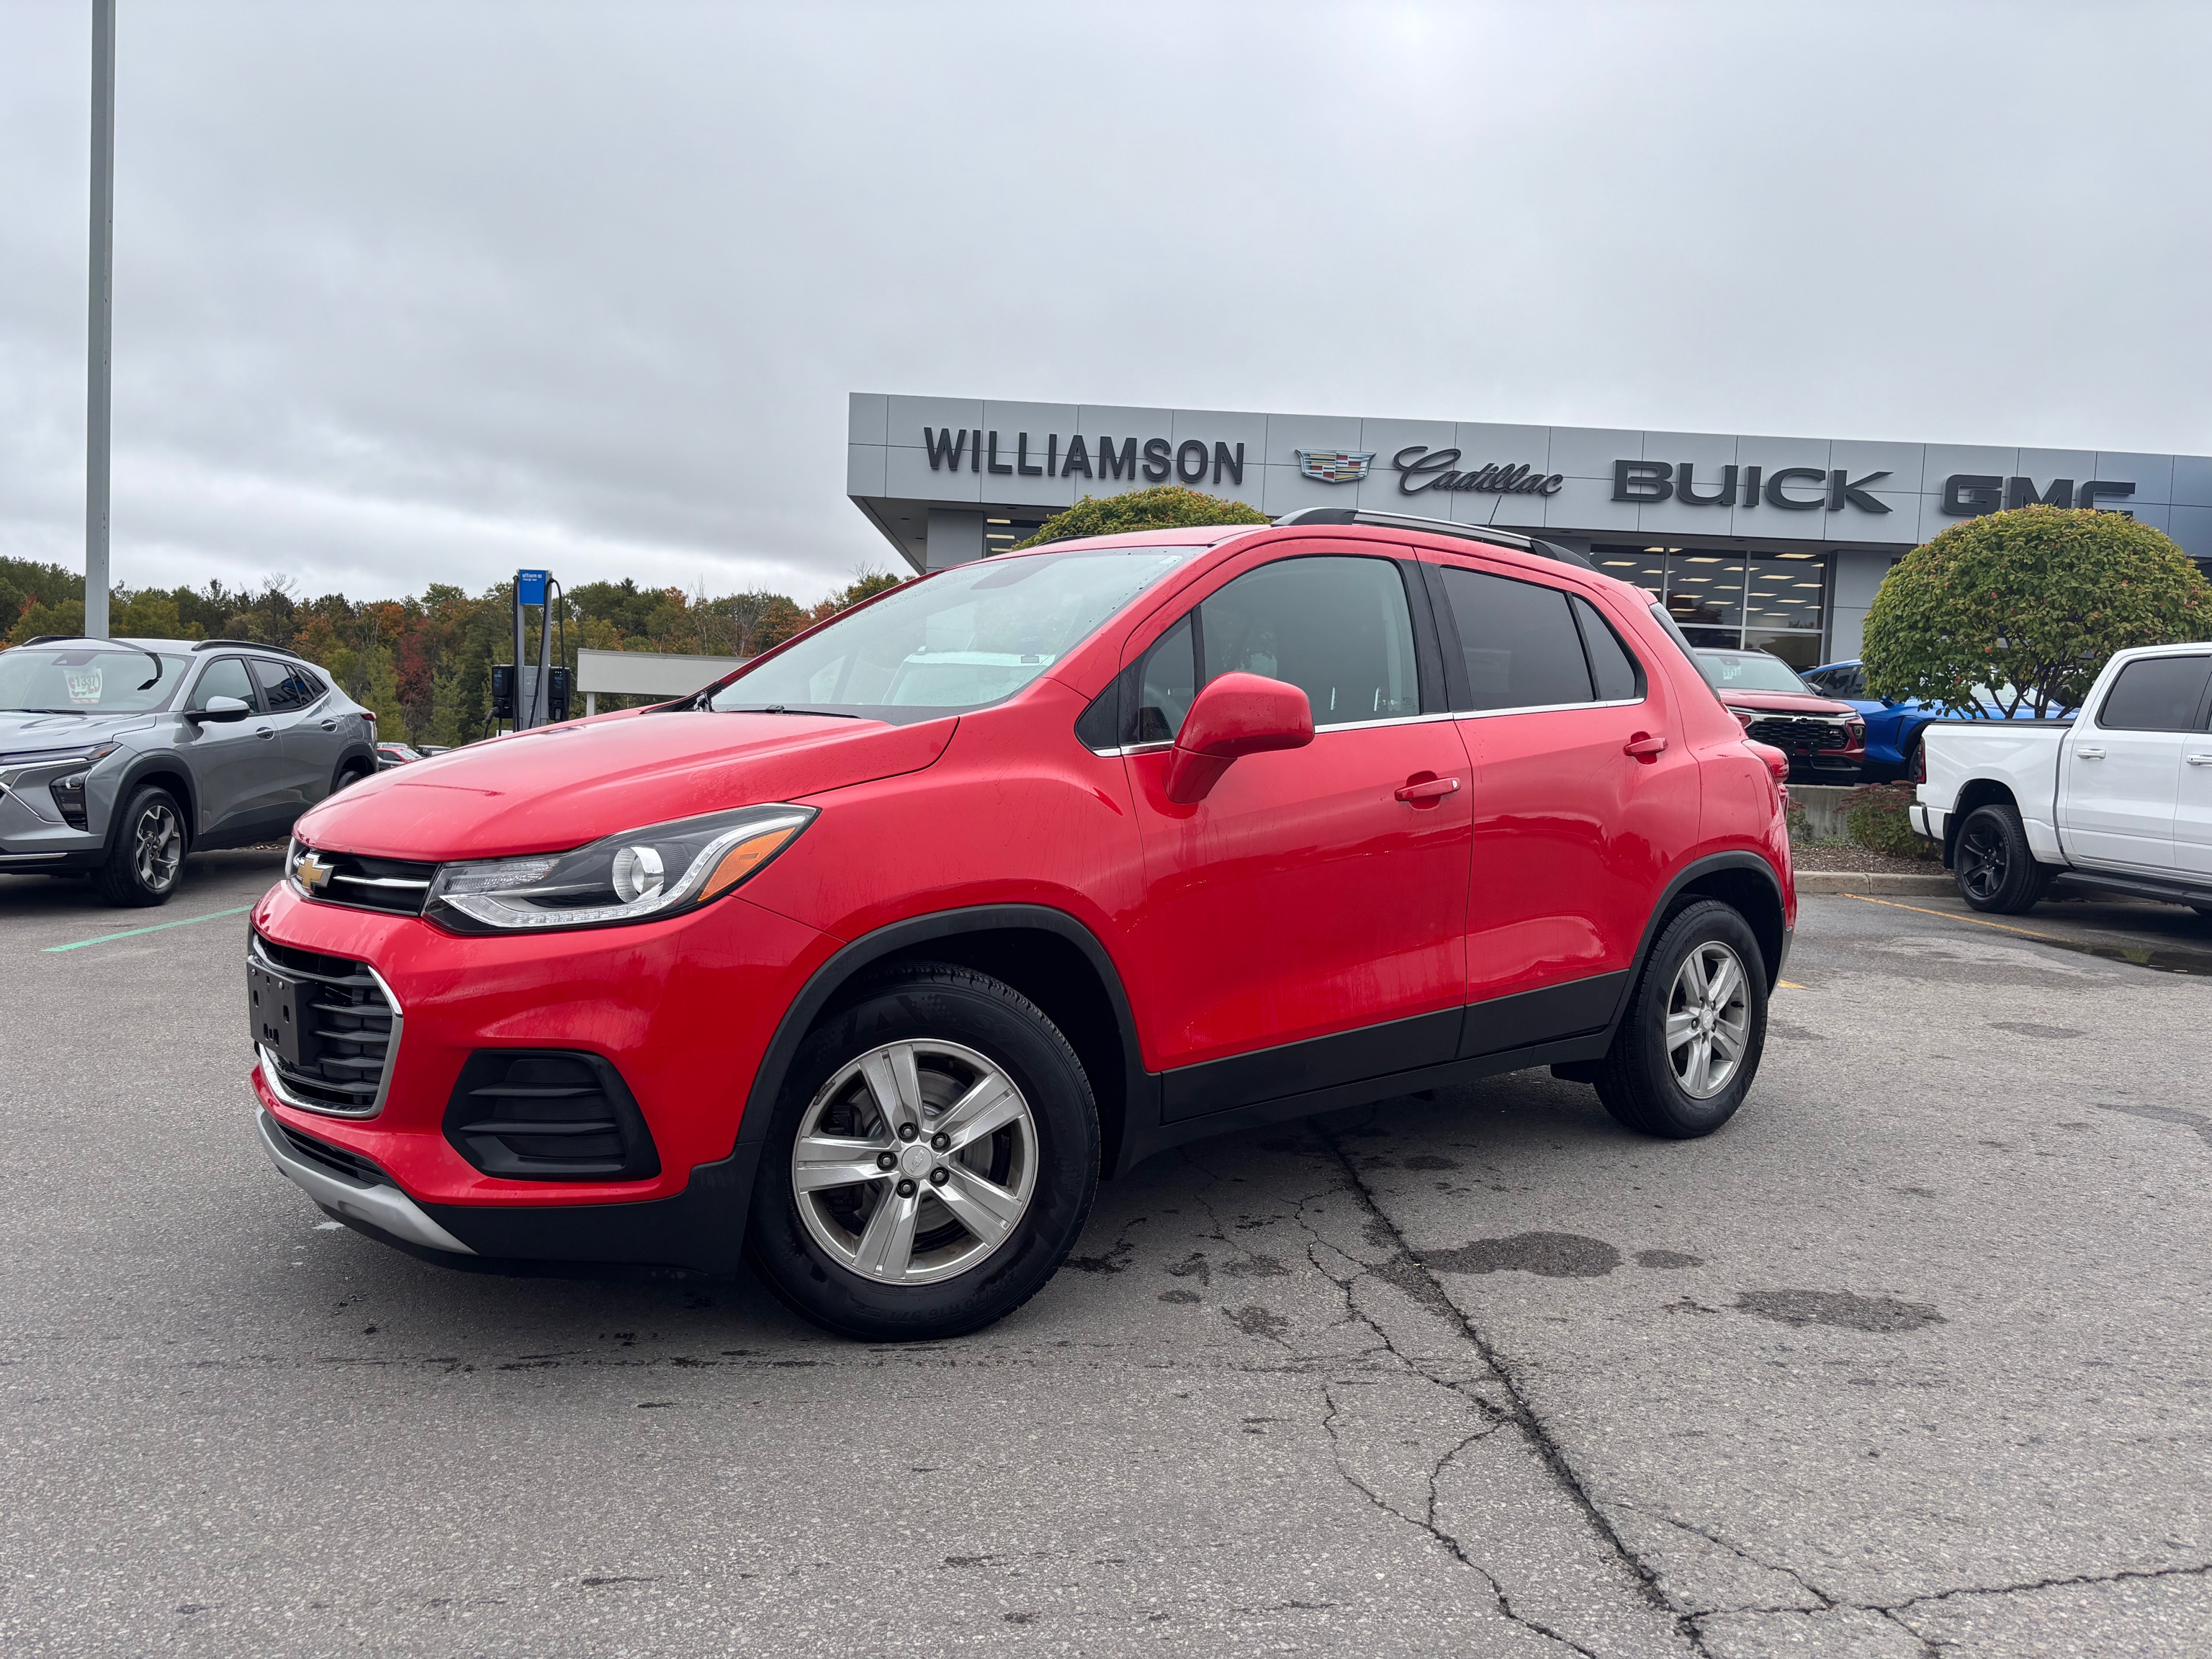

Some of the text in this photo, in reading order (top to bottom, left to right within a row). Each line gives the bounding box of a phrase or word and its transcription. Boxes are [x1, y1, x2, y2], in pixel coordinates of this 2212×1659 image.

[923, 426, 1244, 484] WILLIAMSON
[1393, 446, 1564, 495] Cadillac
[1610, 459, 1894, 513] BUICK
[1941, 474, 2136, 519] GMC
[74, 675, 96, 687] 1337
